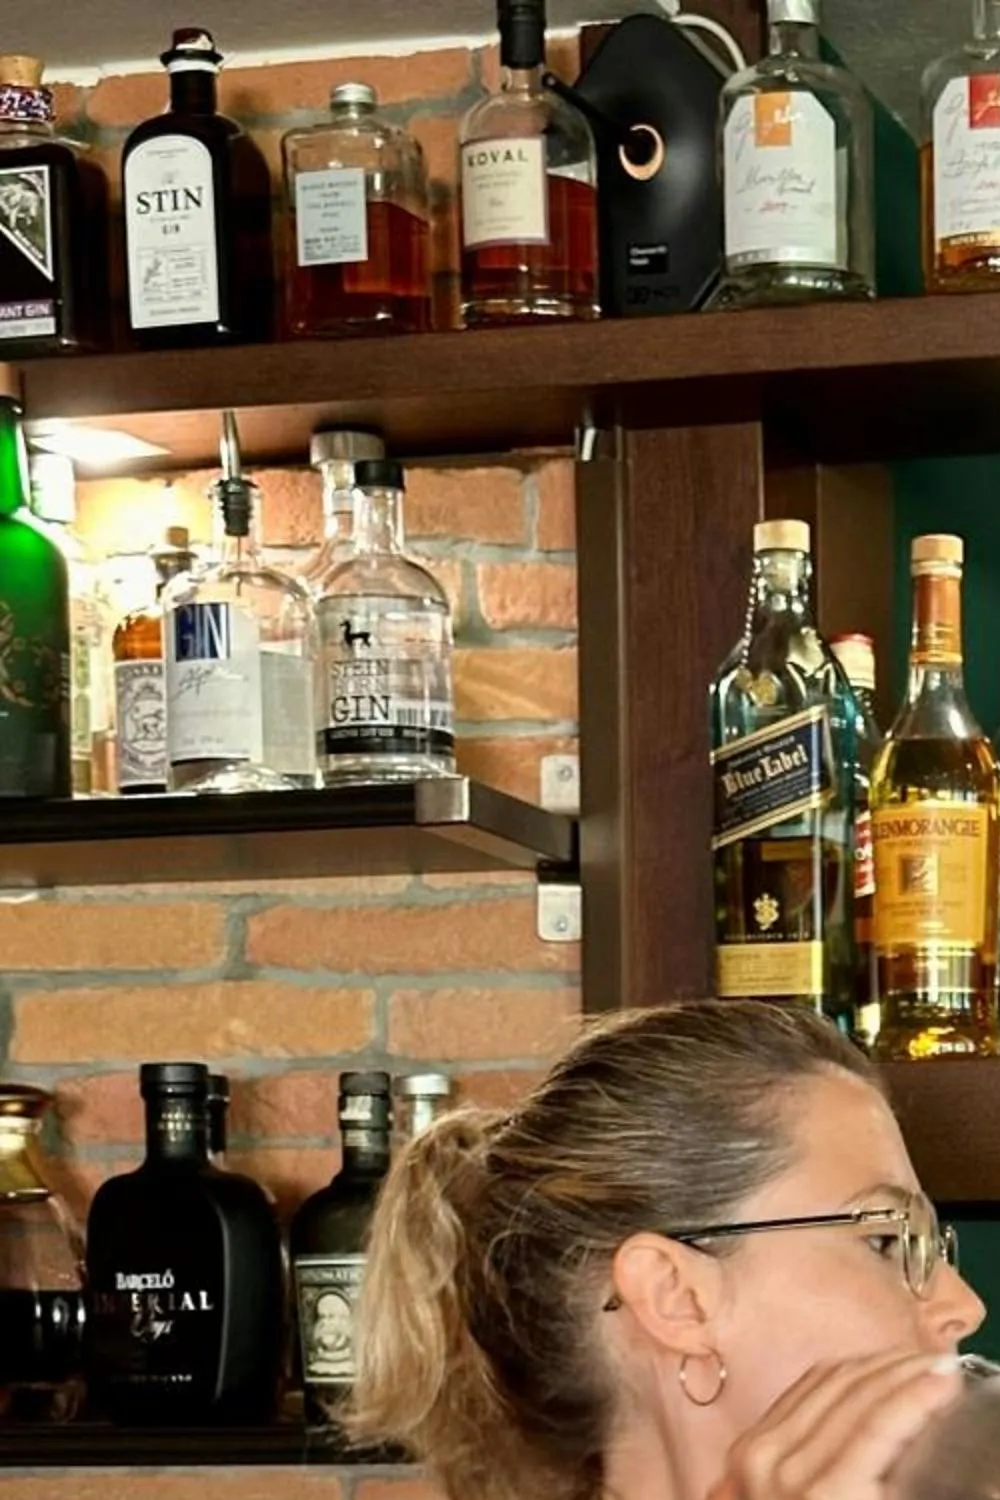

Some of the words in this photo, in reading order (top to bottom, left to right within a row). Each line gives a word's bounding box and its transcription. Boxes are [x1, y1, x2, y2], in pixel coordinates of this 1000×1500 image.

[467, 148, 529, 168] KOVAL
[136, 186, 204, 215] STIN
[24, 303, 50, 317] GIN
[175, 604, 229, 661] GIN
[330, 695, 391, 723] GIN
[721, 766, 763, 799] Blue
[759, 743, 809, 780] Label
[871, 818, 982, 840] LENMORANGIE
